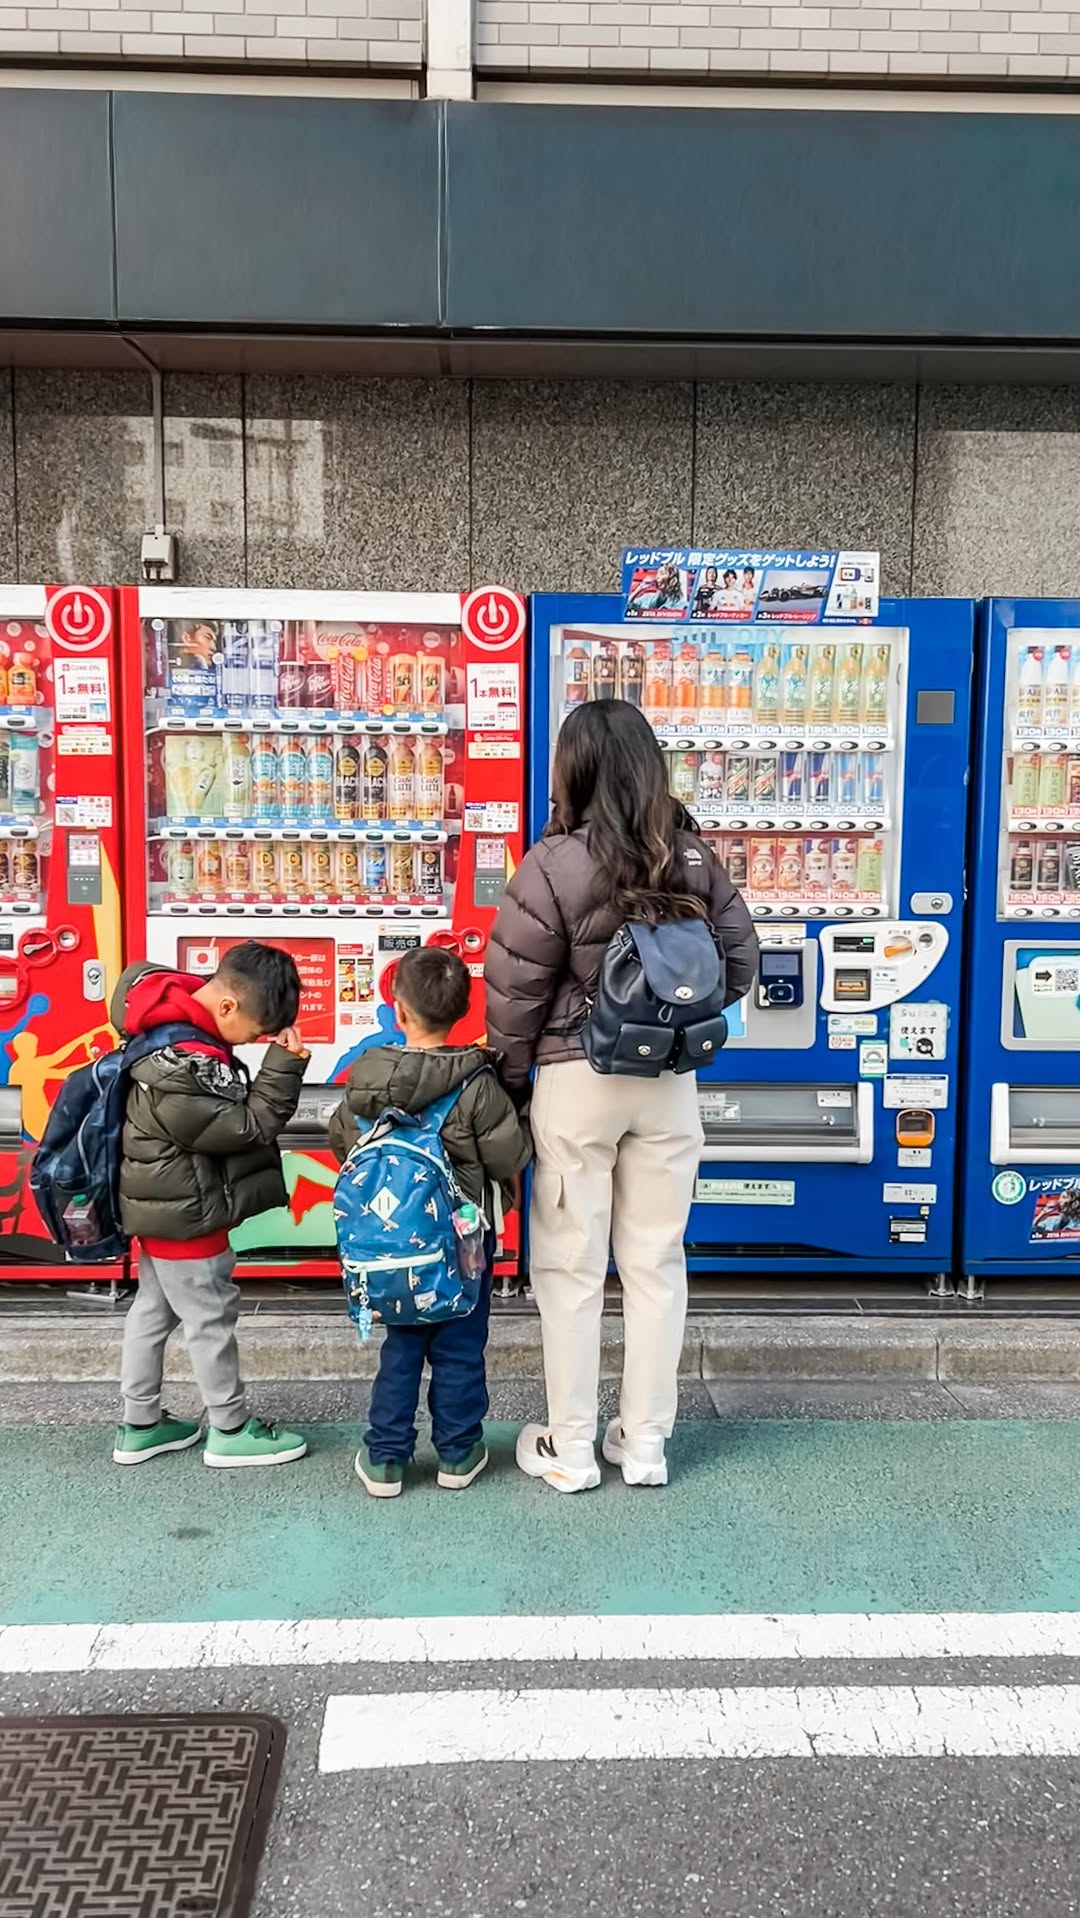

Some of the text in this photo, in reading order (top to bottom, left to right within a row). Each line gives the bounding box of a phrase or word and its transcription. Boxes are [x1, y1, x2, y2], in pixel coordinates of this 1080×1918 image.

[625, 551, 836, 569] レッドブル 限定グッズをゲットしよう!
[58, 674, 107, 695] 1本無料!
[470, 677, 517, 699] 1本無料!
[384, 937, 417, 949] 販売中
[900, 1026, 937, 1035] 使えます
